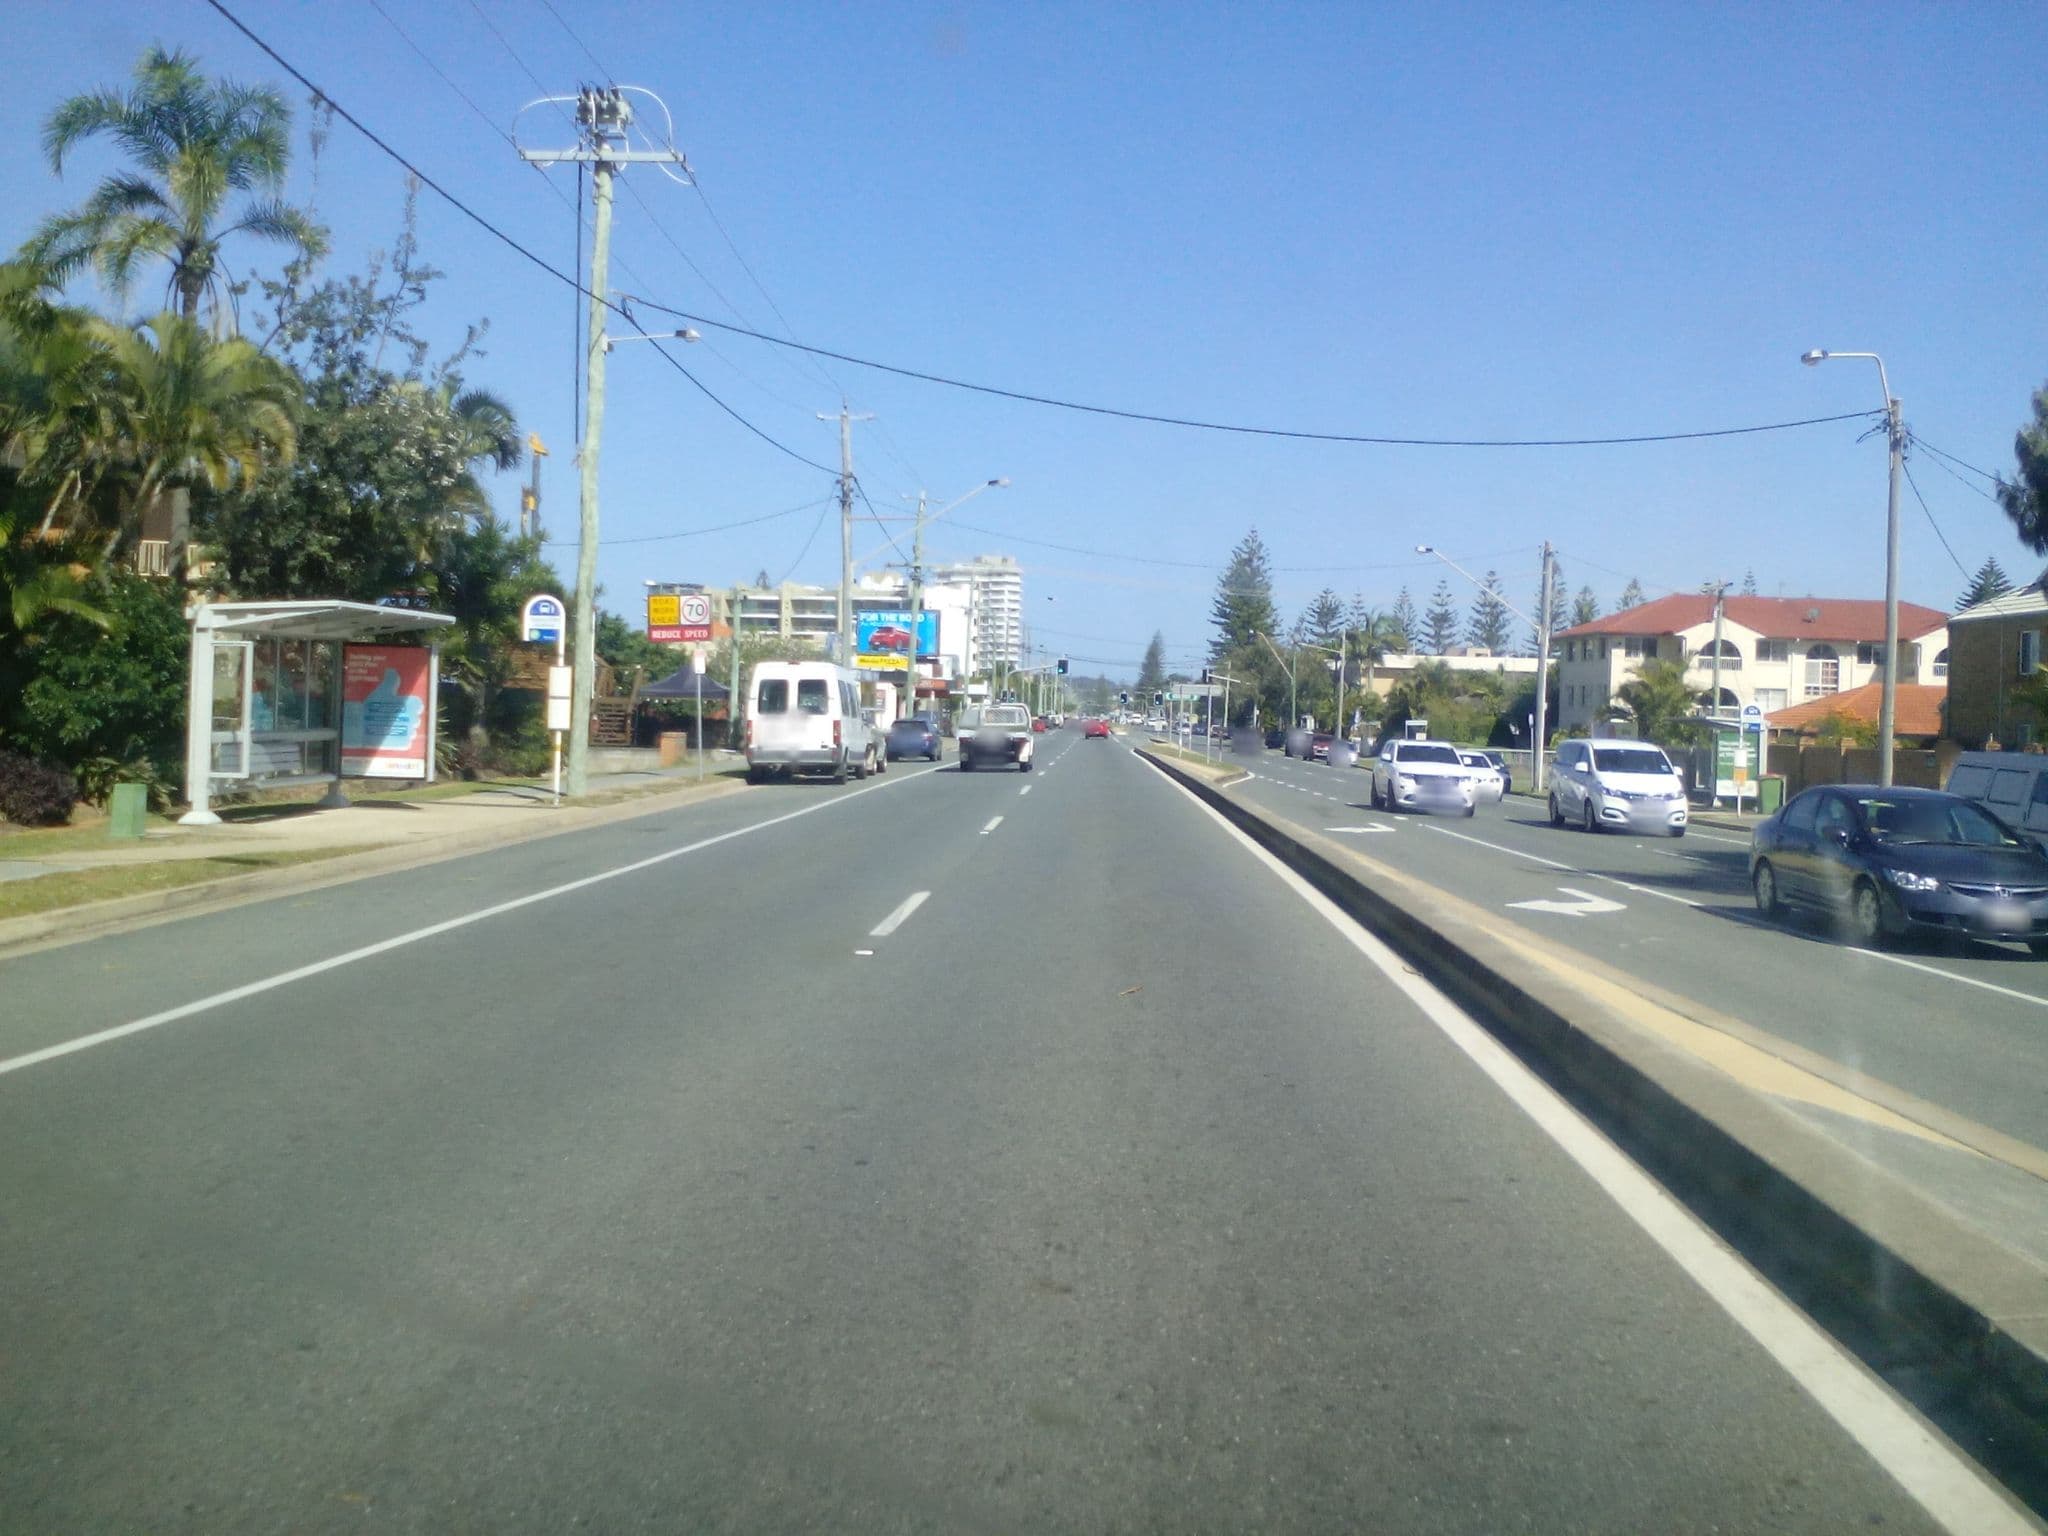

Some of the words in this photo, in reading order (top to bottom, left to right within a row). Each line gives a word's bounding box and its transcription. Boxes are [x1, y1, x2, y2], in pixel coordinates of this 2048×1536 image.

[686, 603, 705, 617] 70
[860, 612, 880, 622] FOR
[881, 612, 898, 622] THE
[899, 612, 926, 623] BOD
[651, 630, 682, 639] REDUCE
[684, 630, 709, 639] SPEED
